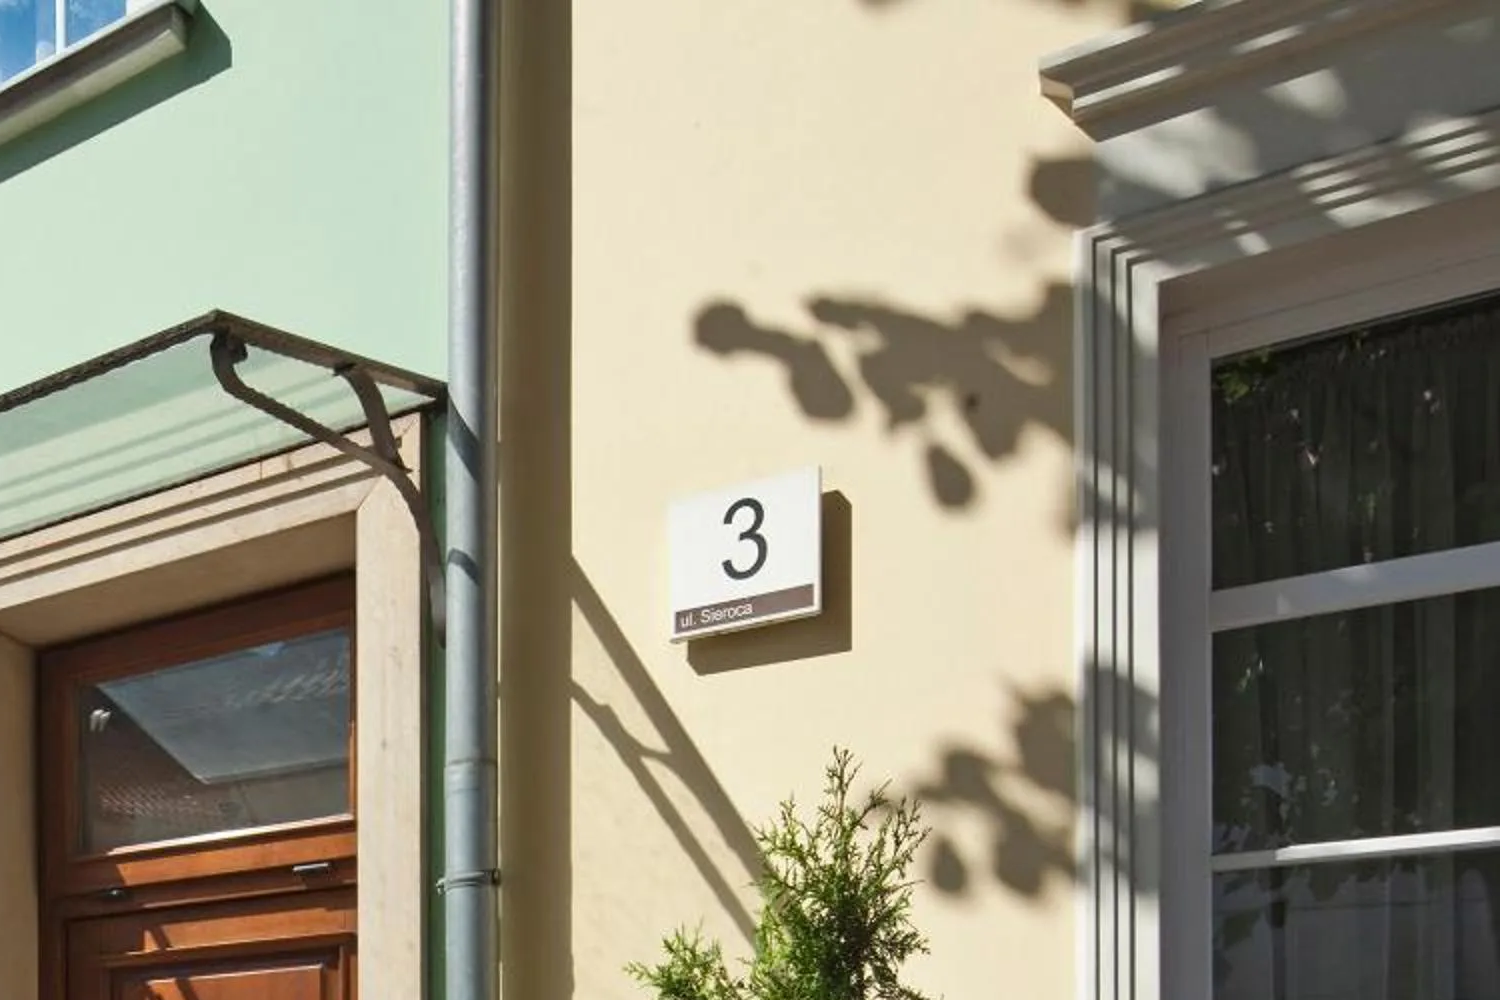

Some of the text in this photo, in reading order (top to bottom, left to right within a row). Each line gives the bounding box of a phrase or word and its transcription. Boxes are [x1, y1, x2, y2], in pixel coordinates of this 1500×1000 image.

[722, 497, 767, 580] 3
[680, 603, 752, 628] ul. Sieroca
